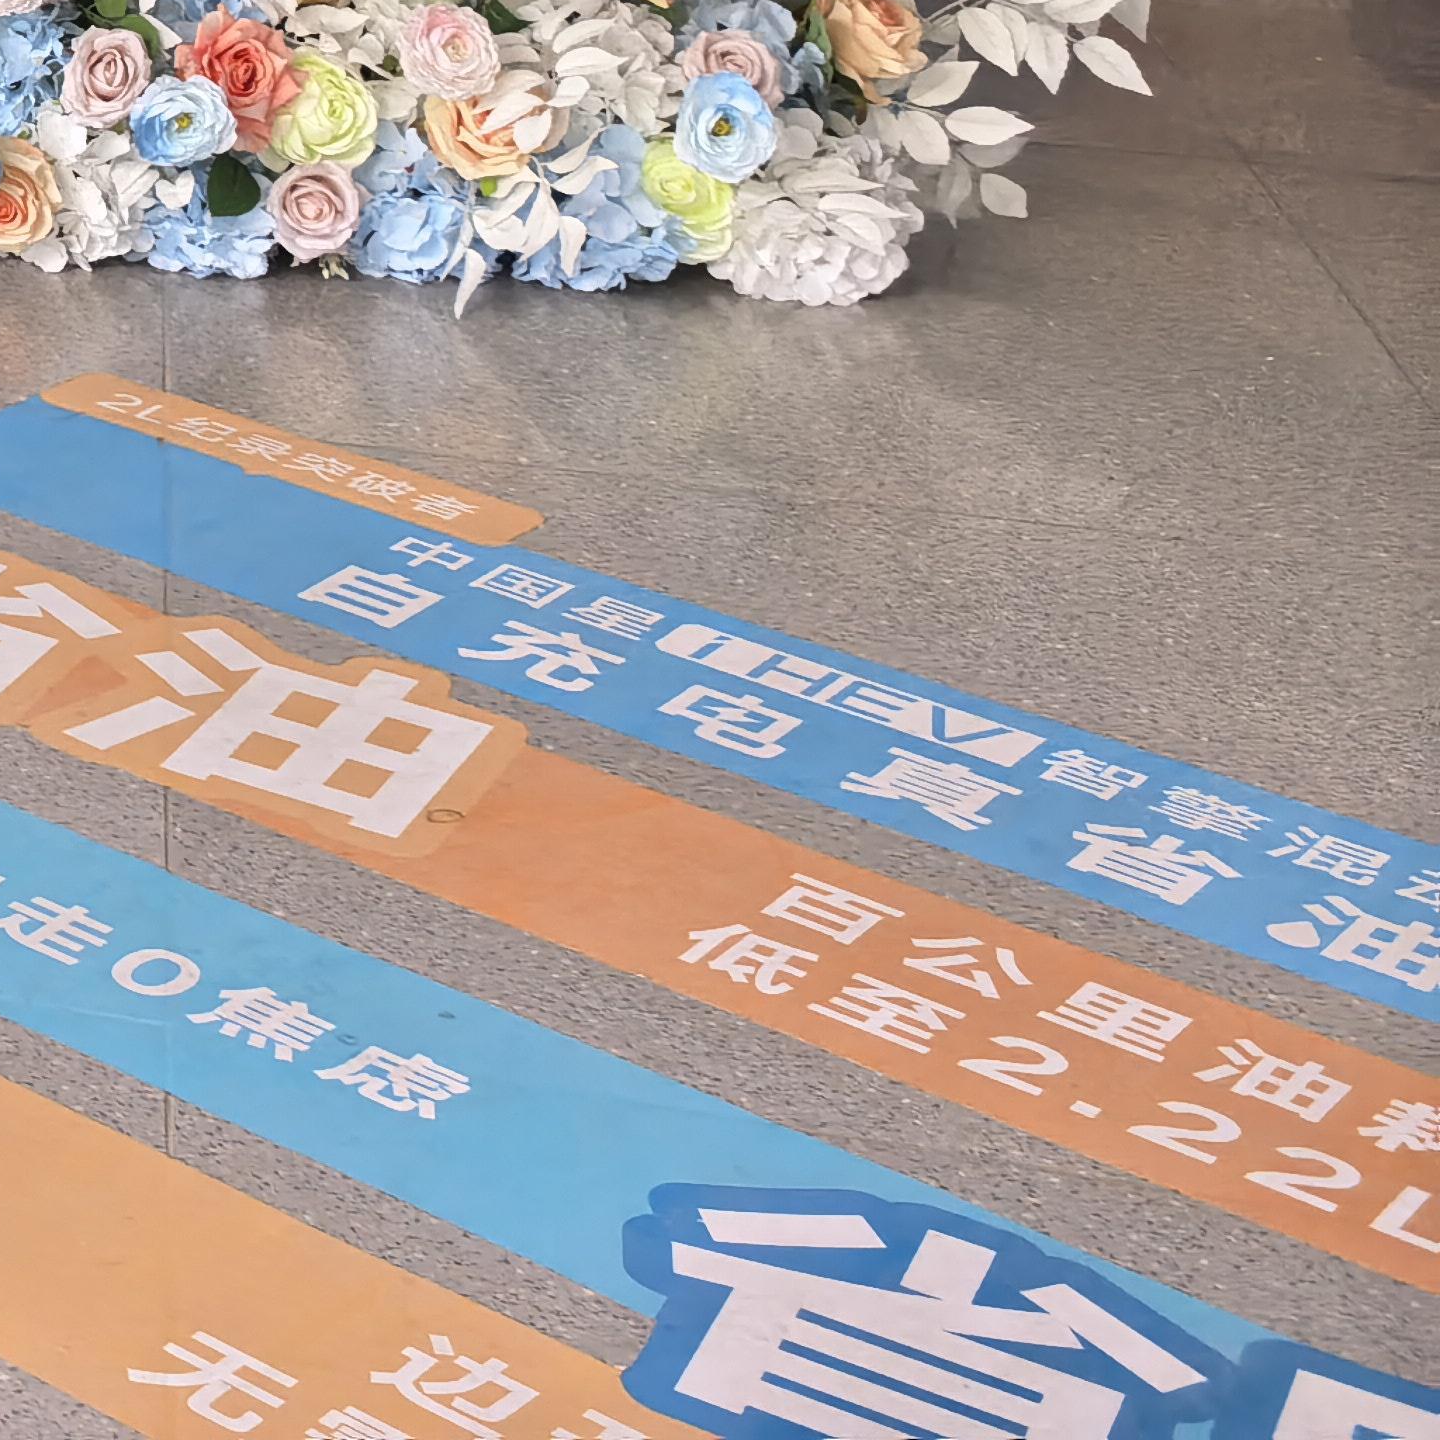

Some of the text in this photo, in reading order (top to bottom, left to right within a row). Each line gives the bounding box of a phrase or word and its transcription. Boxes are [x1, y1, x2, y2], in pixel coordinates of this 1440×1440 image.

[96, 392, 481, 522] 2L纪录突破者
